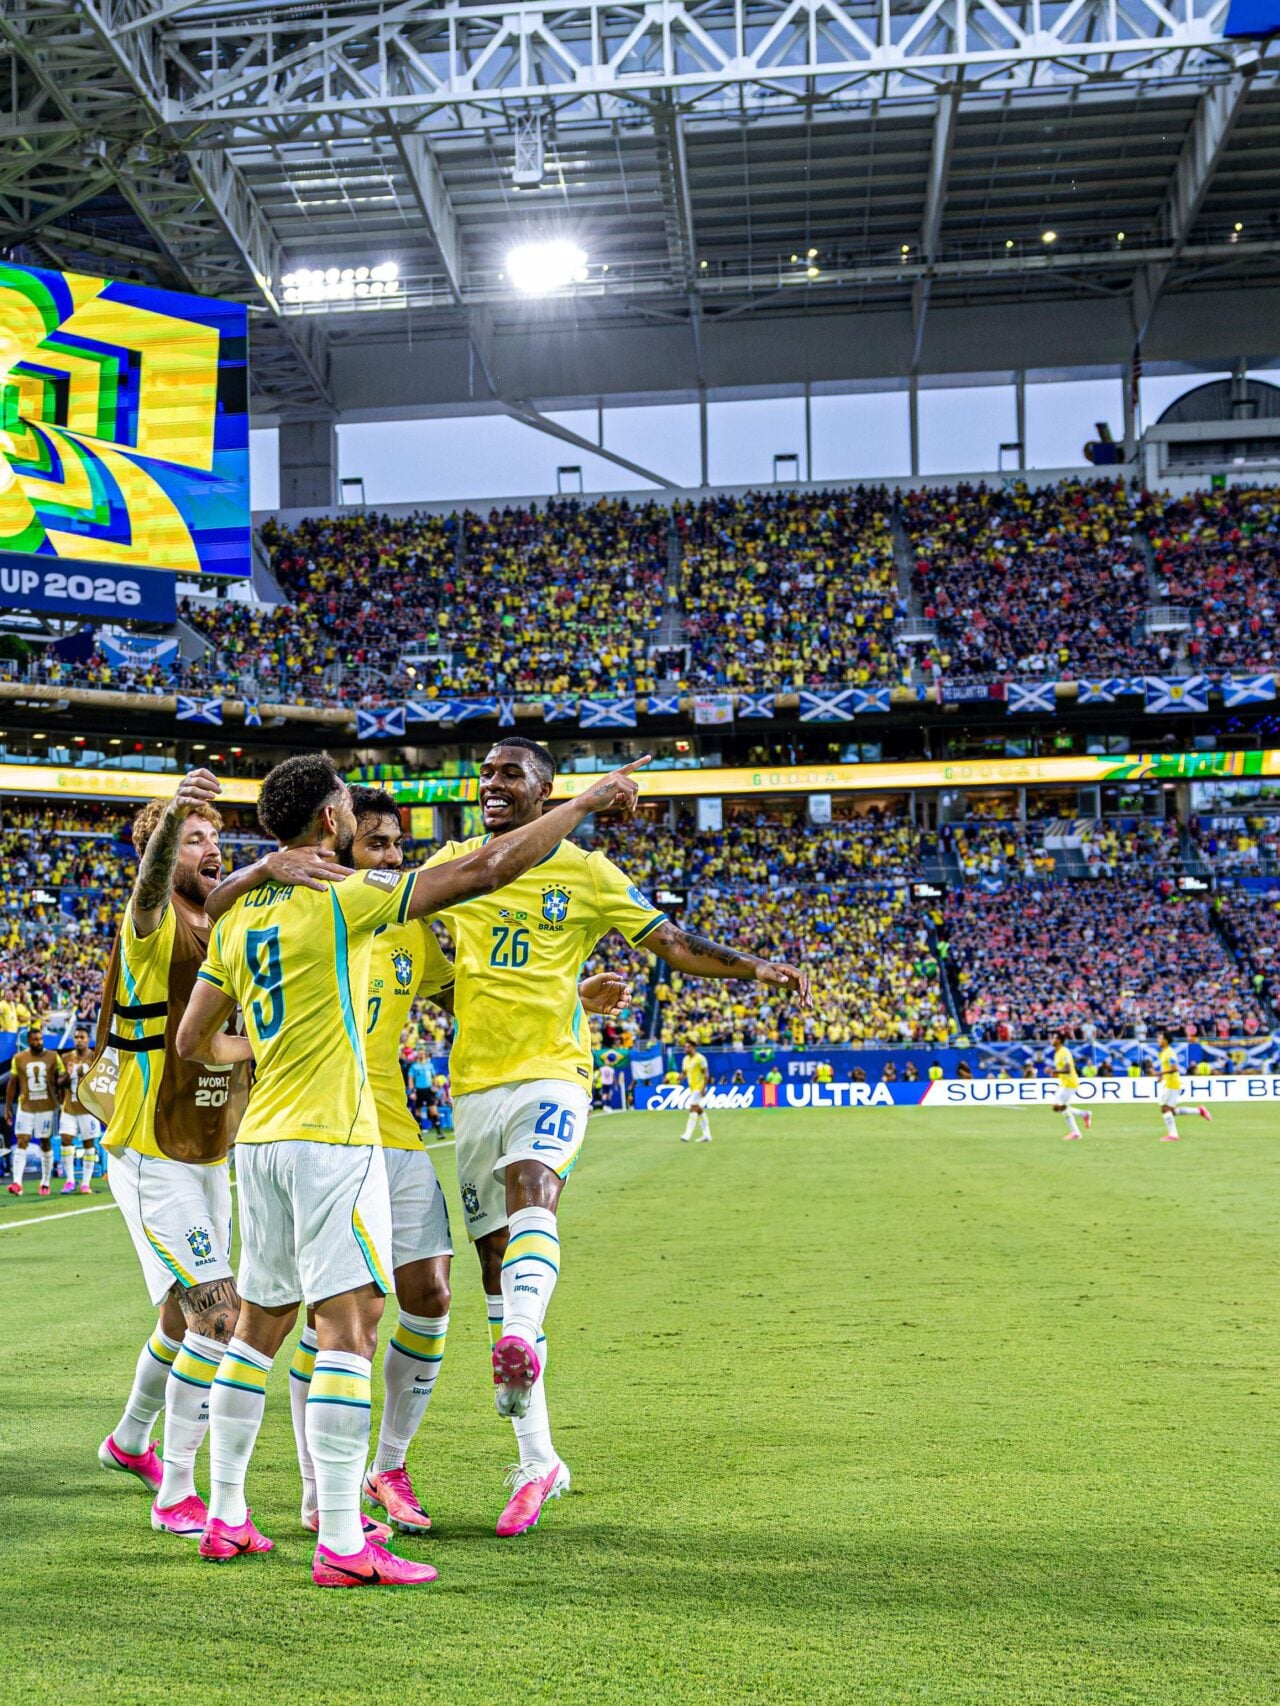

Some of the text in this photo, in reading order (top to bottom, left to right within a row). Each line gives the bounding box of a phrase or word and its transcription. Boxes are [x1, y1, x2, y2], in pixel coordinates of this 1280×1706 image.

[44, 573, 141, 605] 2026
[538, 923, 564, 931] BRASIL
[490, 926, 530, 968] 26
[245, 924, 286, 1041] 9
[786, 1083, 894, 1107] ULTRA
[947, 1081, 1121, 1101] SUPEROR
[1132, 1079, 1236, 1099] LIHT
[535, 1102, 576, 1143] 26
[469, 1211, 488, 1223] BRASIL
[195, 1257, 217, 1267] BRASIL
[513, 1285, 540, 1296] BRASIL
